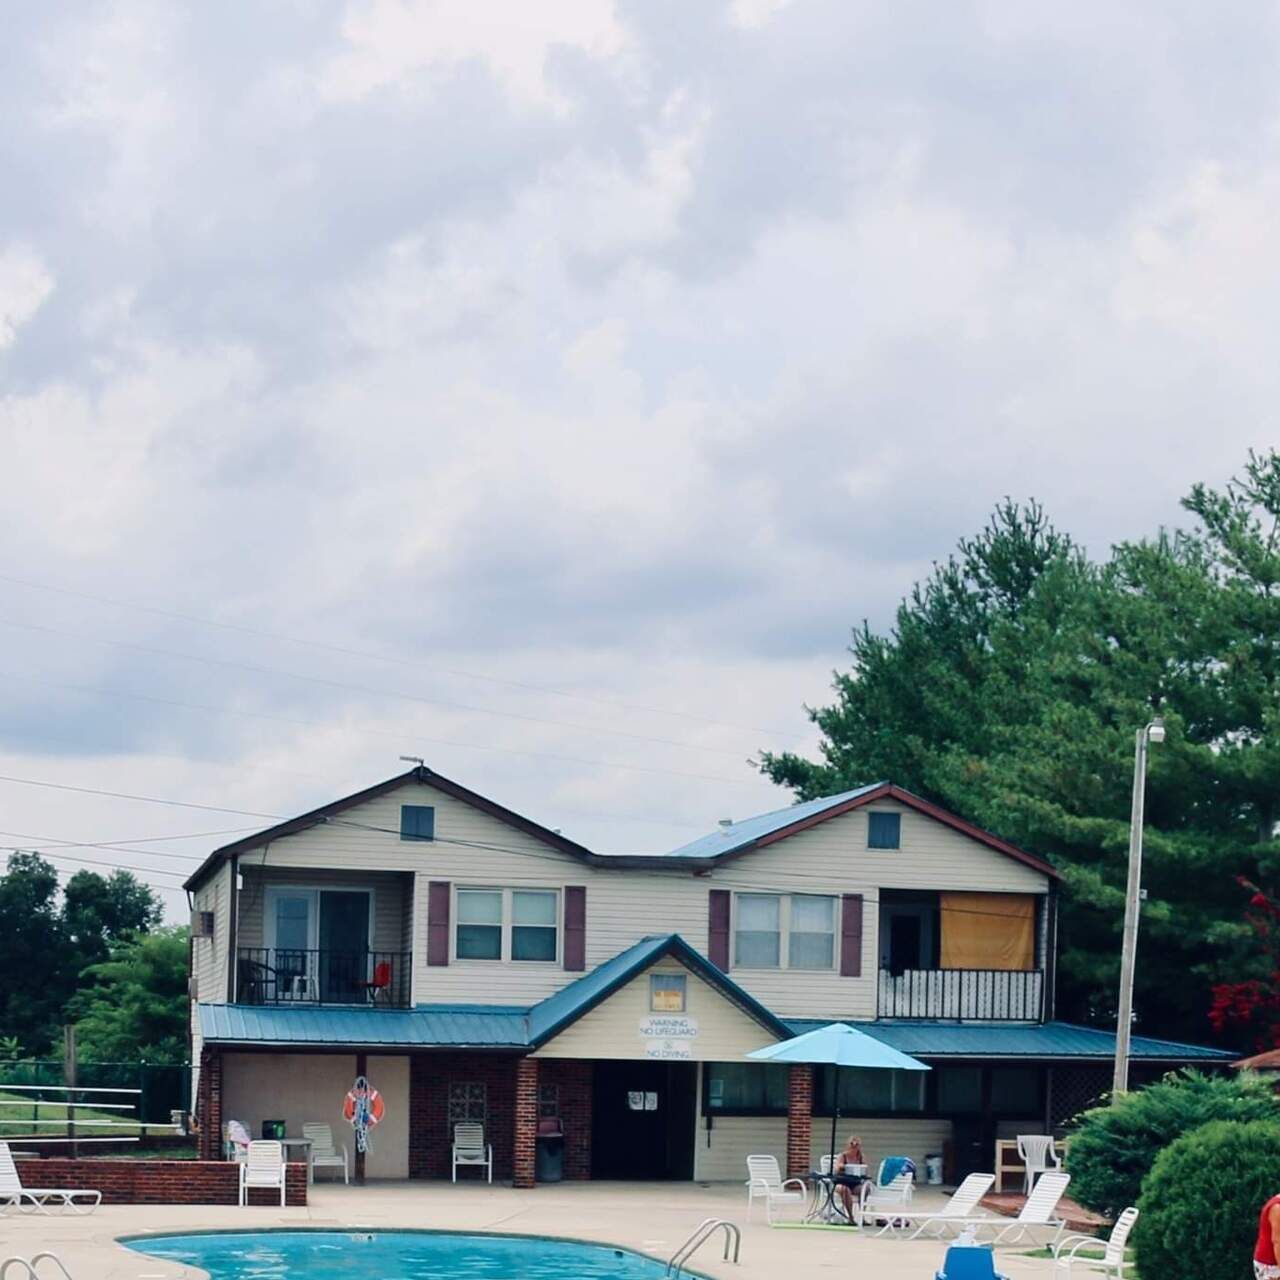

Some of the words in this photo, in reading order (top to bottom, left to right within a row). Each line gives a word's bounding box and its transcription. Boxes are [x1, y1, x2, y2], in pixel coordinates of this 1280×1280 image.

[648, 1019, 688, 1028] WARNING
[639, 1027, 653, 1035] NO
[655, 1027, 697, 1036] LIFEGUARD
[647, 1050, 660, 1058] NO
[662, 1050, 689, 1058] DIVING
